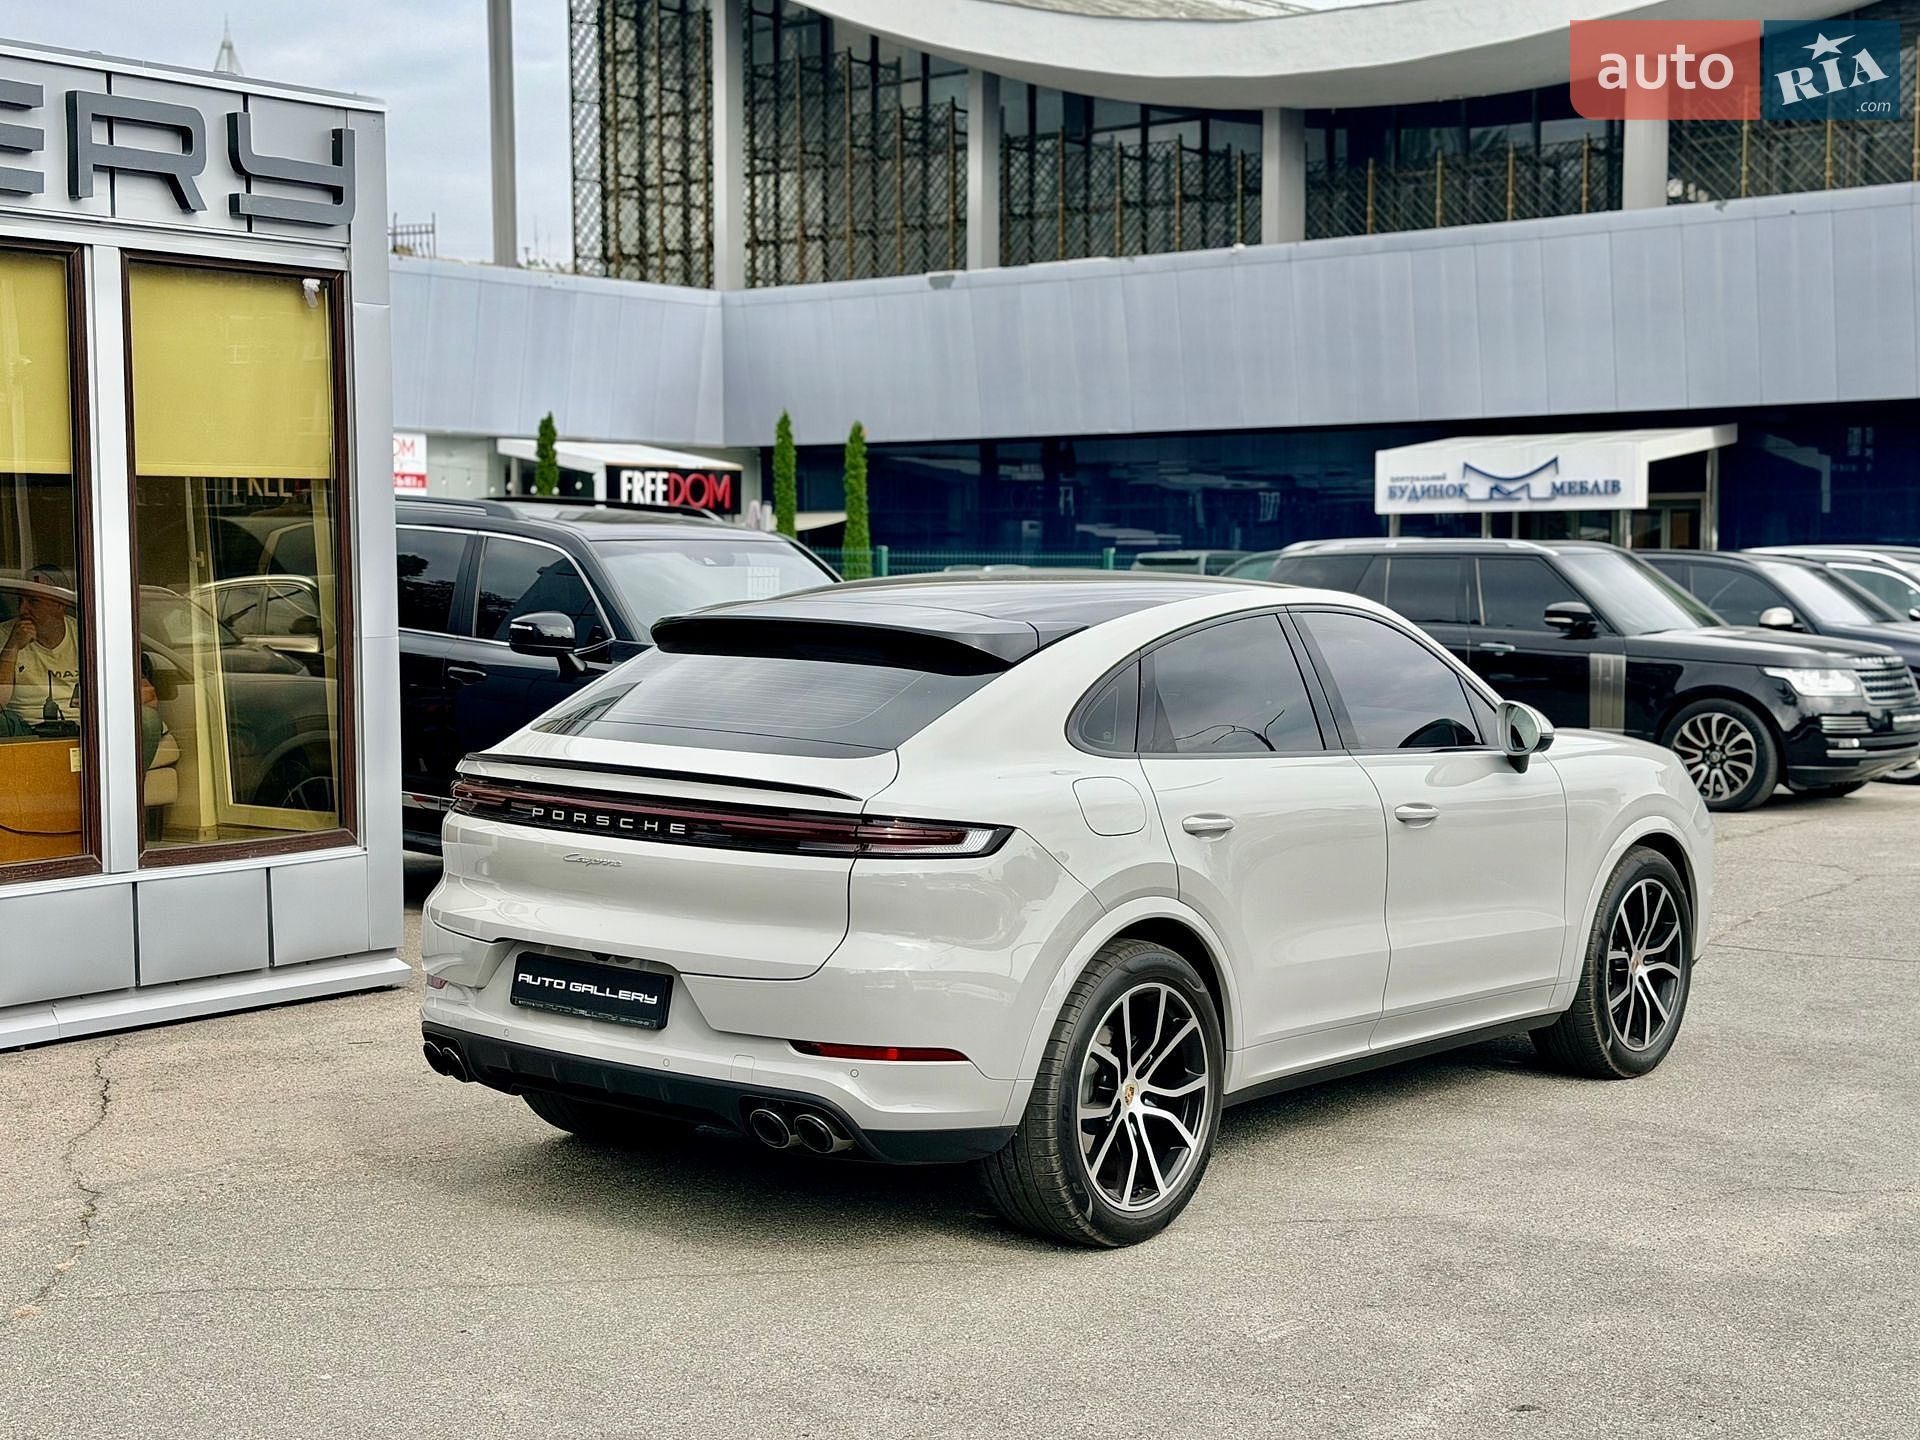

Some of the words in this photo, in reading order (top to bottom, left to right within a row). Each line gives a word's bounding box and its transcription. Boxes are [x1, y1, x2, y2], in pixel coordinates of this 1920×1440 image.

[620, 470, 731, 510] FREEDOM
[1388, 482, 1469, 503] БУДИНОК
[1551, 479, 1622, 498] МЕБЛІВ
[532, 807, 686, 835] PORSCHE
[518, 973, 566, 990] AUTO
[569, 982, 658, 1005] GALLERY
